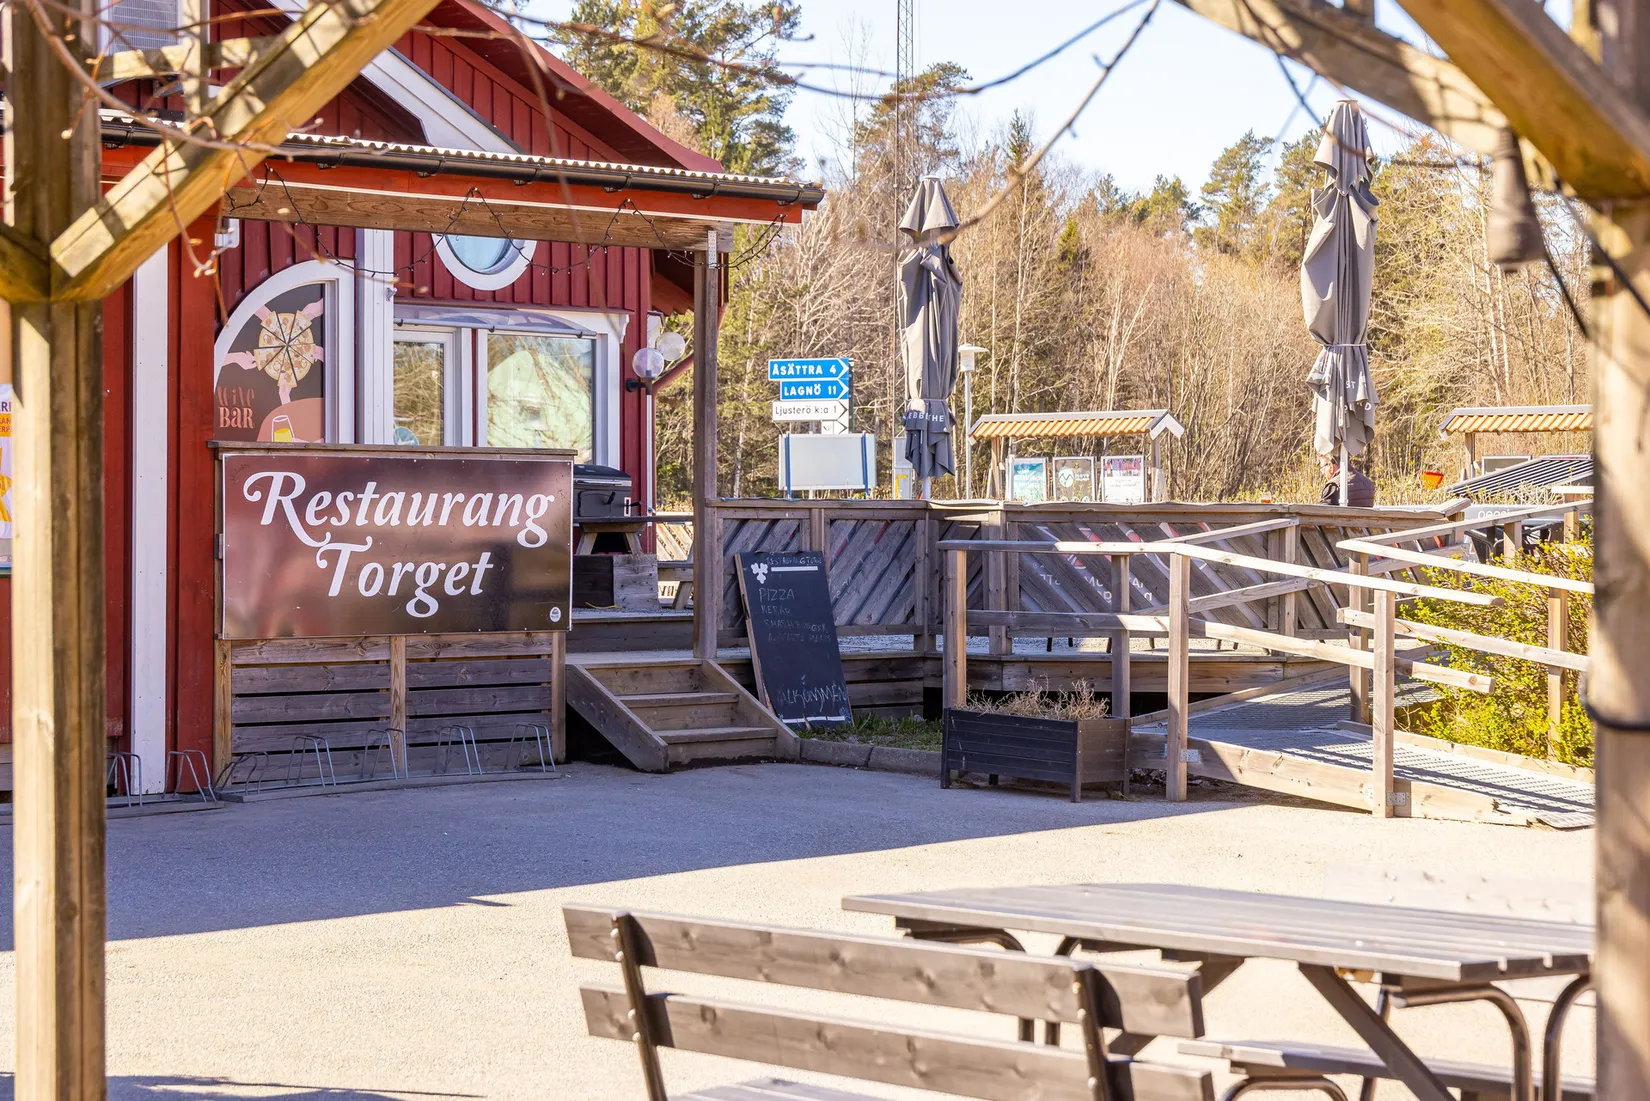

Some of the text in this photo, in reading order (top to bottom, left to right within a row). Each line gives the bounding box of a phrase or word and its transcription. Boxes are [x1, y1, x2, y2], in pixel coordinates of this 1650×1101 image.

[772, 363, 837, 376] ÅSÄTTRA 4
[784, 384, 837, 396] LAGNÖ 11
[775, 405, 811, 416] Ljusterö
[814, 406, 829, 414] k:a
[243, 471, 555, 548] Restaurang
[315, 536, 494, 618] Torget
[758, 588, 795, 603] PIZZA
